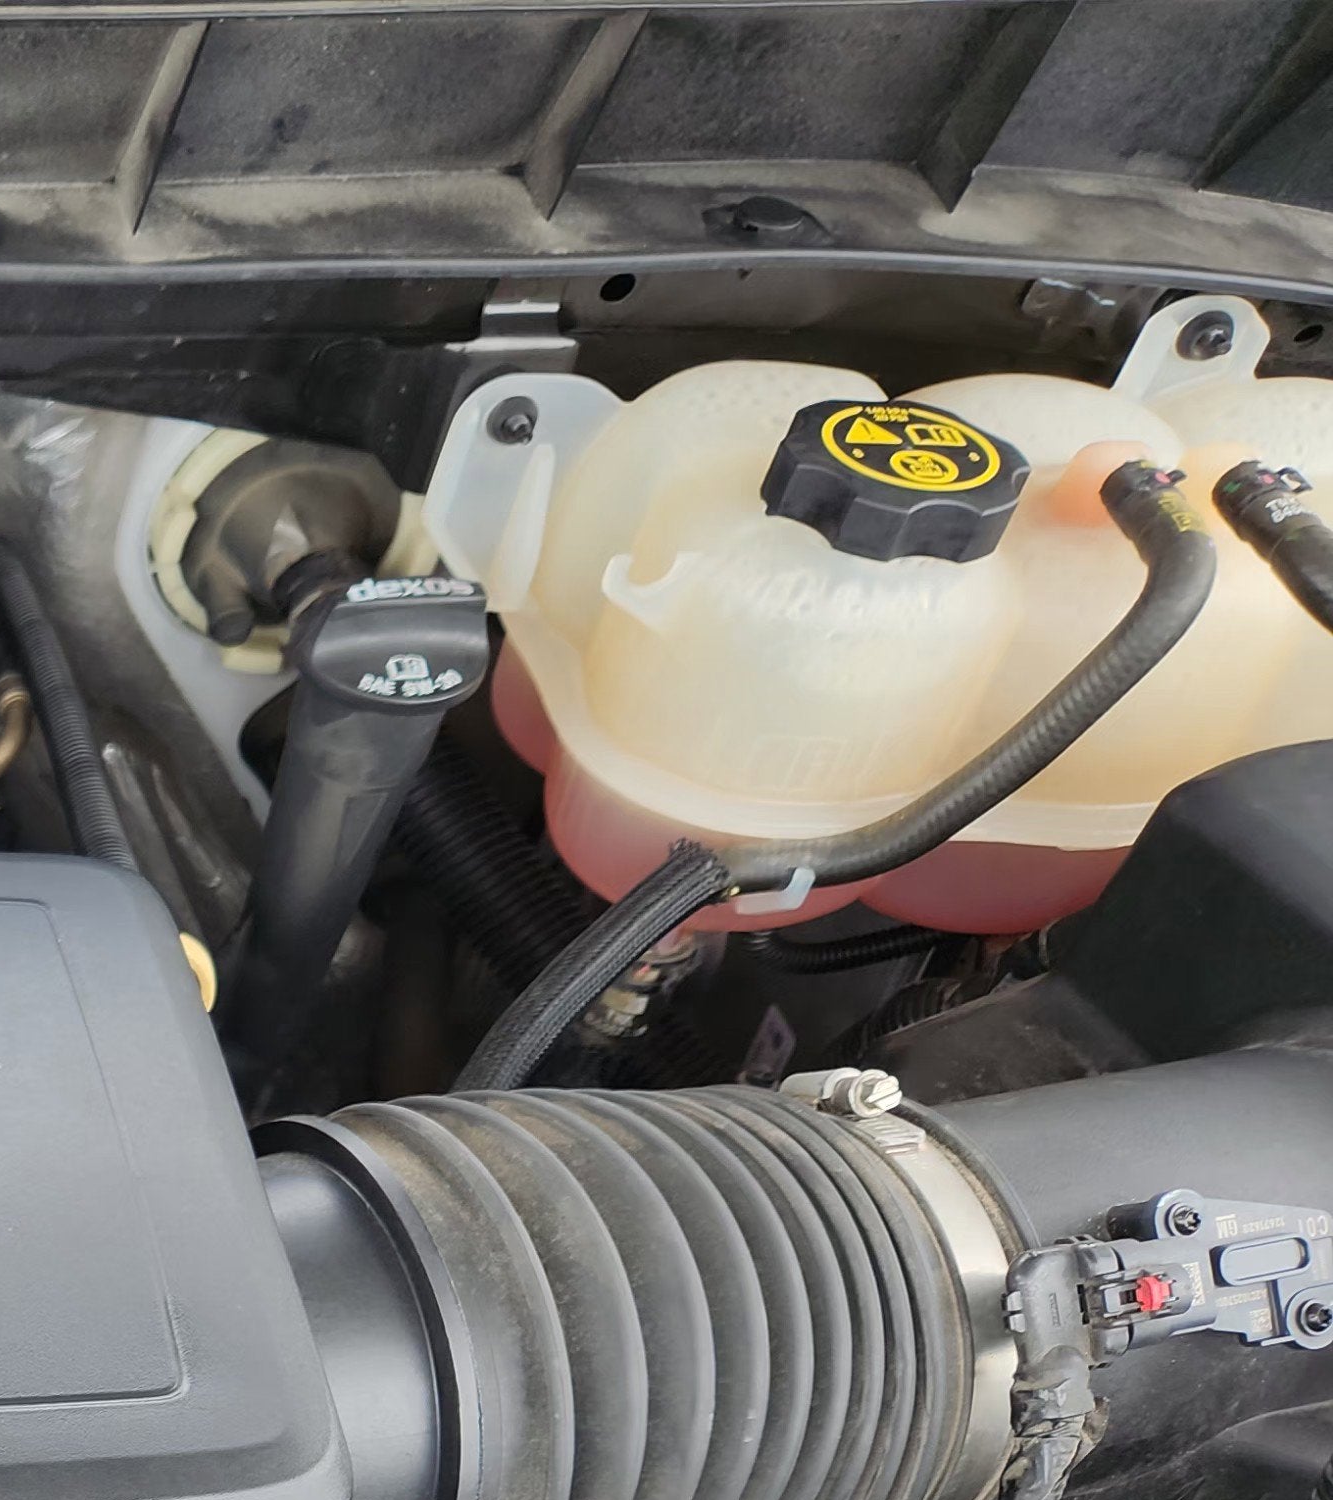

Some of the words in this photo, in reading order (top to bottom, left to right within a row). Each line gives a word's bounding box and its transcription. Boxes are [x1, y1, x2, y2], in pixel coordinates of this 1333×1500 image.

[347, 577, 475, 602] dexos
[357, 673, 397, 696] SAE
[1217, 1215, 1238, 1239] GM
